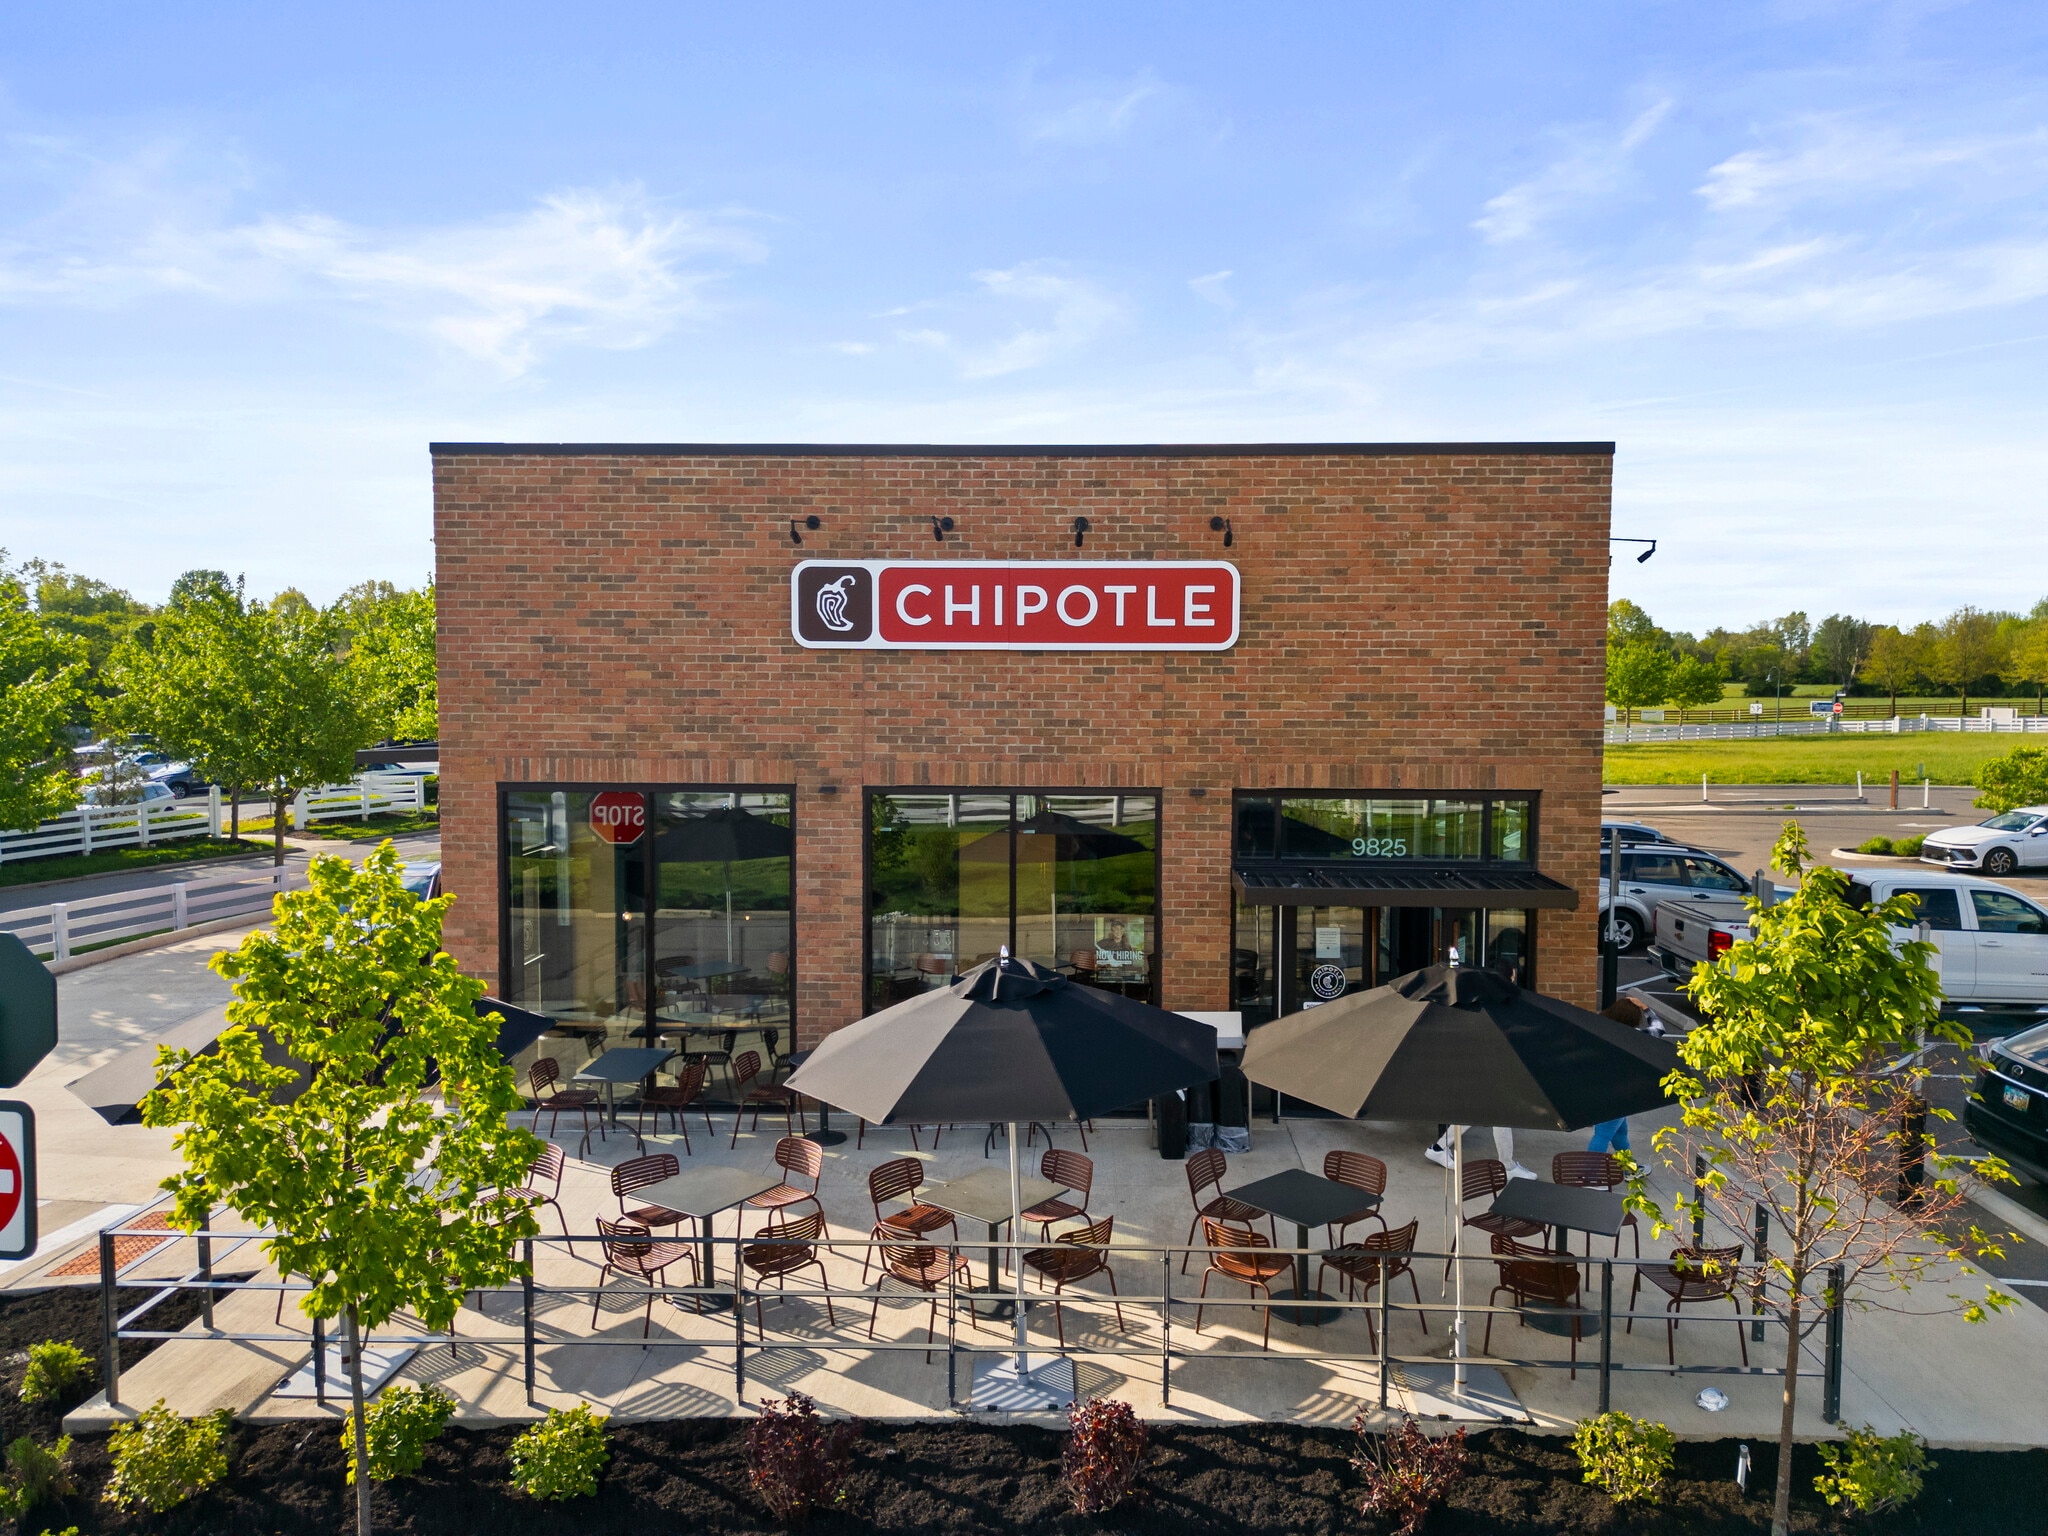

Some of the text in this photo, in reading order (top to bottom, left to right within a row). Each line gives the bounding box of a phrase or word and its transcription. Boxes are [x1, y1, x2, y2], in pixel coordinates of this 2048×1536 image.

[895, 583, 1216, 627] CHIPOTLE
[1352, 837, 1407, 856] 9825
[1096, 950, 1143, 960] NOW HIRING
[1314, 966, 1343, 979] CHIPOTLE
